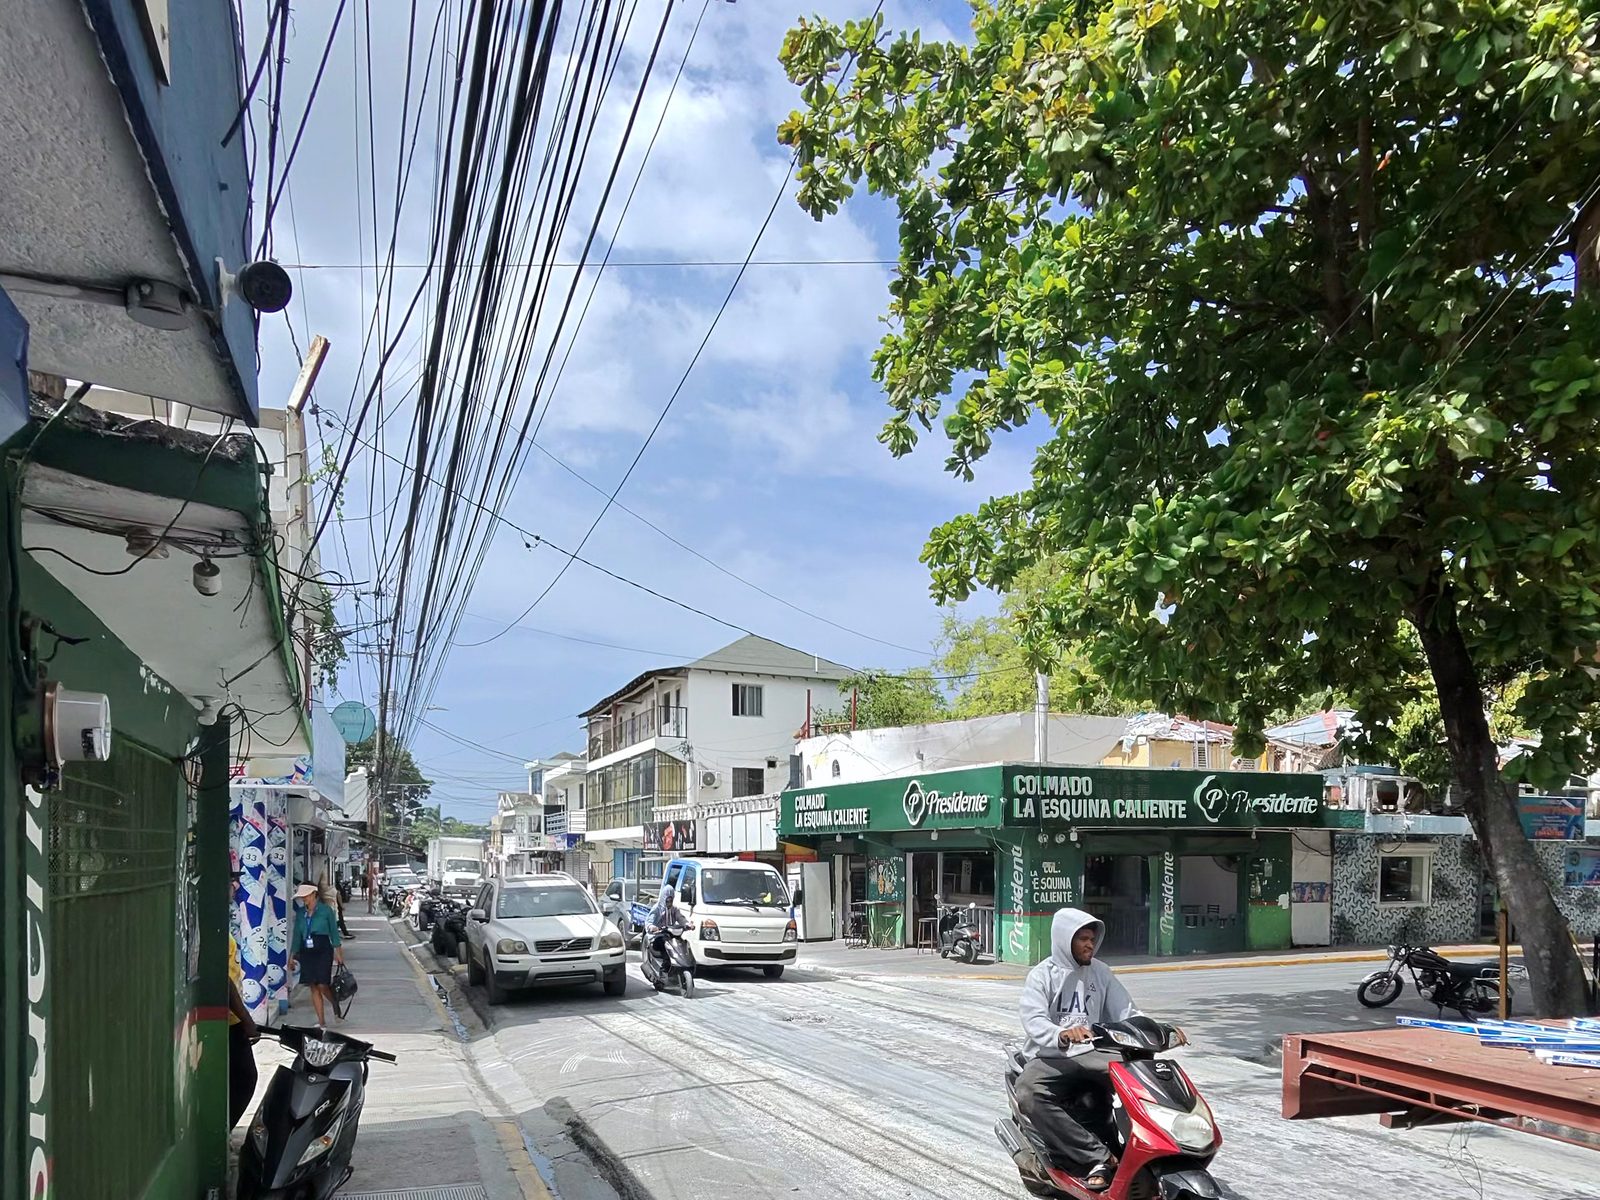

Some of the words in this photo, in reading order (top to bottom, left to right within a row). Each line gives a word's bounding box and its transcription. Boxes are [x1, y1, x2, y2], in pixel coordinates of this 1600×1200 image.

[1013, 775, 1093, 796] COLMADO
[794, 793, 825, 811] COLMADO
[926, 790, 988, 815] Presidente
[1013, 798, 1035, 818] LA
[1042, 799, 1111, 821] ESQUINA
[1113, 799, 1187, 819] CALIENTE
[1231, 790, 1318, 814] Presidente
[794, 813, 803, 828] LA
[803, 811, 833, 829] ESQUINA
[833, 808, 868, 826] CALIENTE
[245, 852, 257, 862] 33
[273, 852, 285, 861] 33
[1033, 877, 1072, 890] ESQUINA
[1159, 851, 1175, 936] Presidente
[1009, 845, 1024, 956] President
[1033, 892, 1072, 903] CALIENTE
